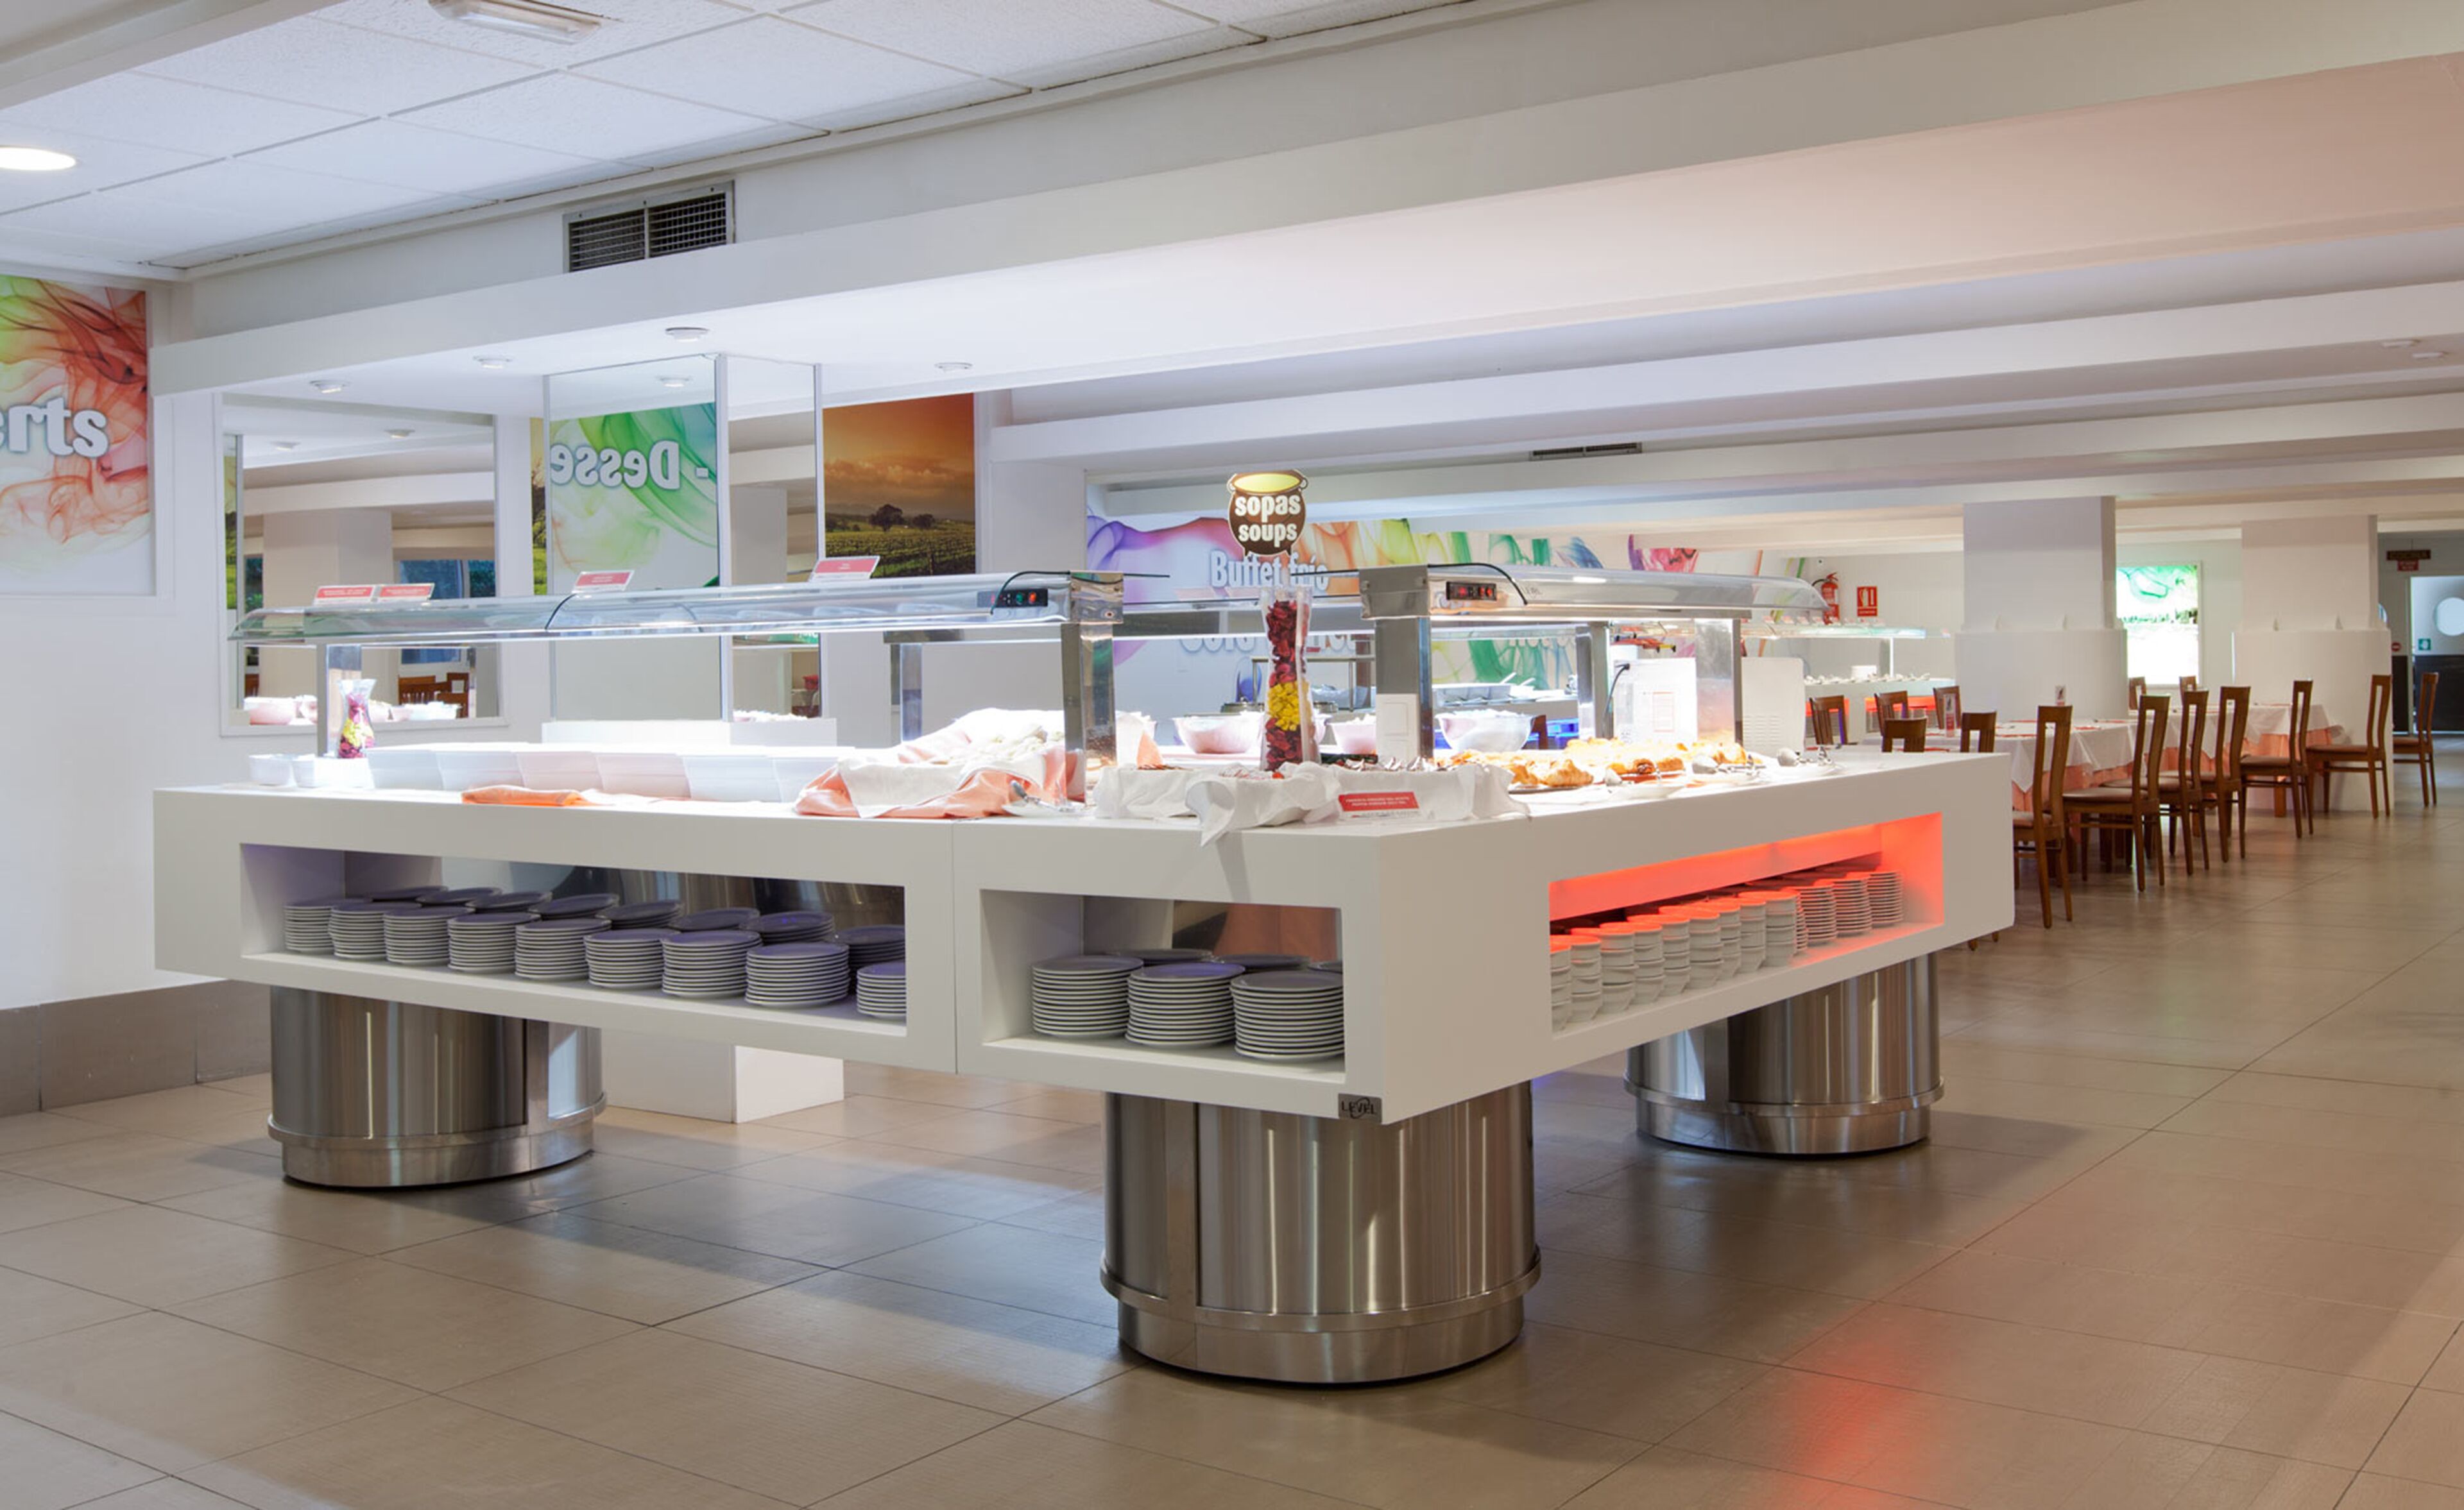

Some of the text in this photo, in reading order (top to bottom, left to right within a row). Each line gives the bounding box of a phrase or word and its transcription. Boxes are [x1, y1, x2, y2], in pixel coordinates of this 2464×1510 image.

[0, 397, 108, 457] rts
[1235, 495, 1301, 523] sopas
[1238, 523, 1297, 548] soups
[1210, 550, 1281, 588] Buffet
